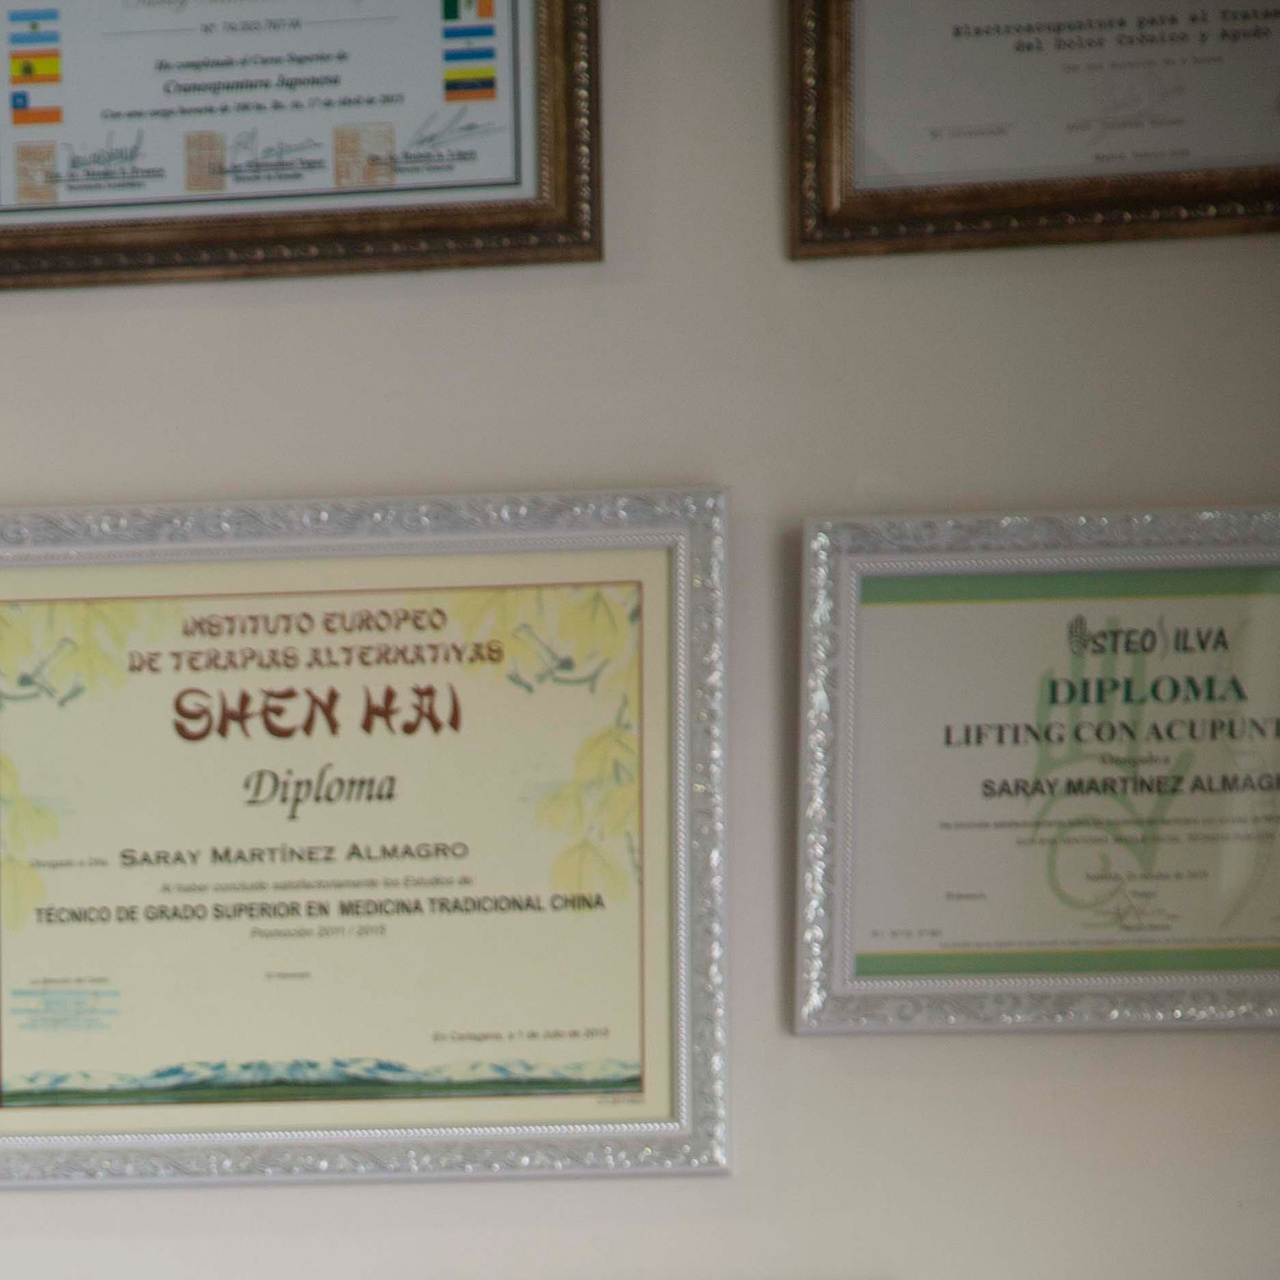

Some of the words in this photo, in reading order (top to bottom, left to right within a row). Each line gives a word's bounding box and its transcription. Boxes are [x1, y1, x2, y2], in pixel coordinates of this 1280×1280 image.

[181, 612, 315, 637] INSTITUTO
[322, 606, 448, 633] EUROPEO
[127, 650, 163, 674] DE
[171, 646, 300, 673] TERAPIAS
[306, 639, 505, 671] ALTERNATIVAS
[1046, 673, 1249, 706] DIPLOMA
[172, 685, 341, 742] SHEN
[360, 682, 463, 736] HAI
[941, 722, 1066, 748] LIFTING
[1072, 719, 1138, 745] CON
[242, 762, 398, 820] Diploma
[981, 777, 1058, 799] SARAY
[119, 847, 202, 868] SARAY
[209, 840, 335, 864] MARTÍNEZ
[343, 841, 469, 862] ALMAGRO
[34, 901, 112, 924] TÉCNICO
[115, 904, 138, 922] DE
[142, 903, 208, 922] GRADO
[212, 900, 302, 921] SUPERIOR
[306, 899, 331, 919] EN
[338, 897, 425, 917] MEDICINA
[428, 895, 546, 915] TRADICIONAL
[549, 892, 607, 912] CHINA
